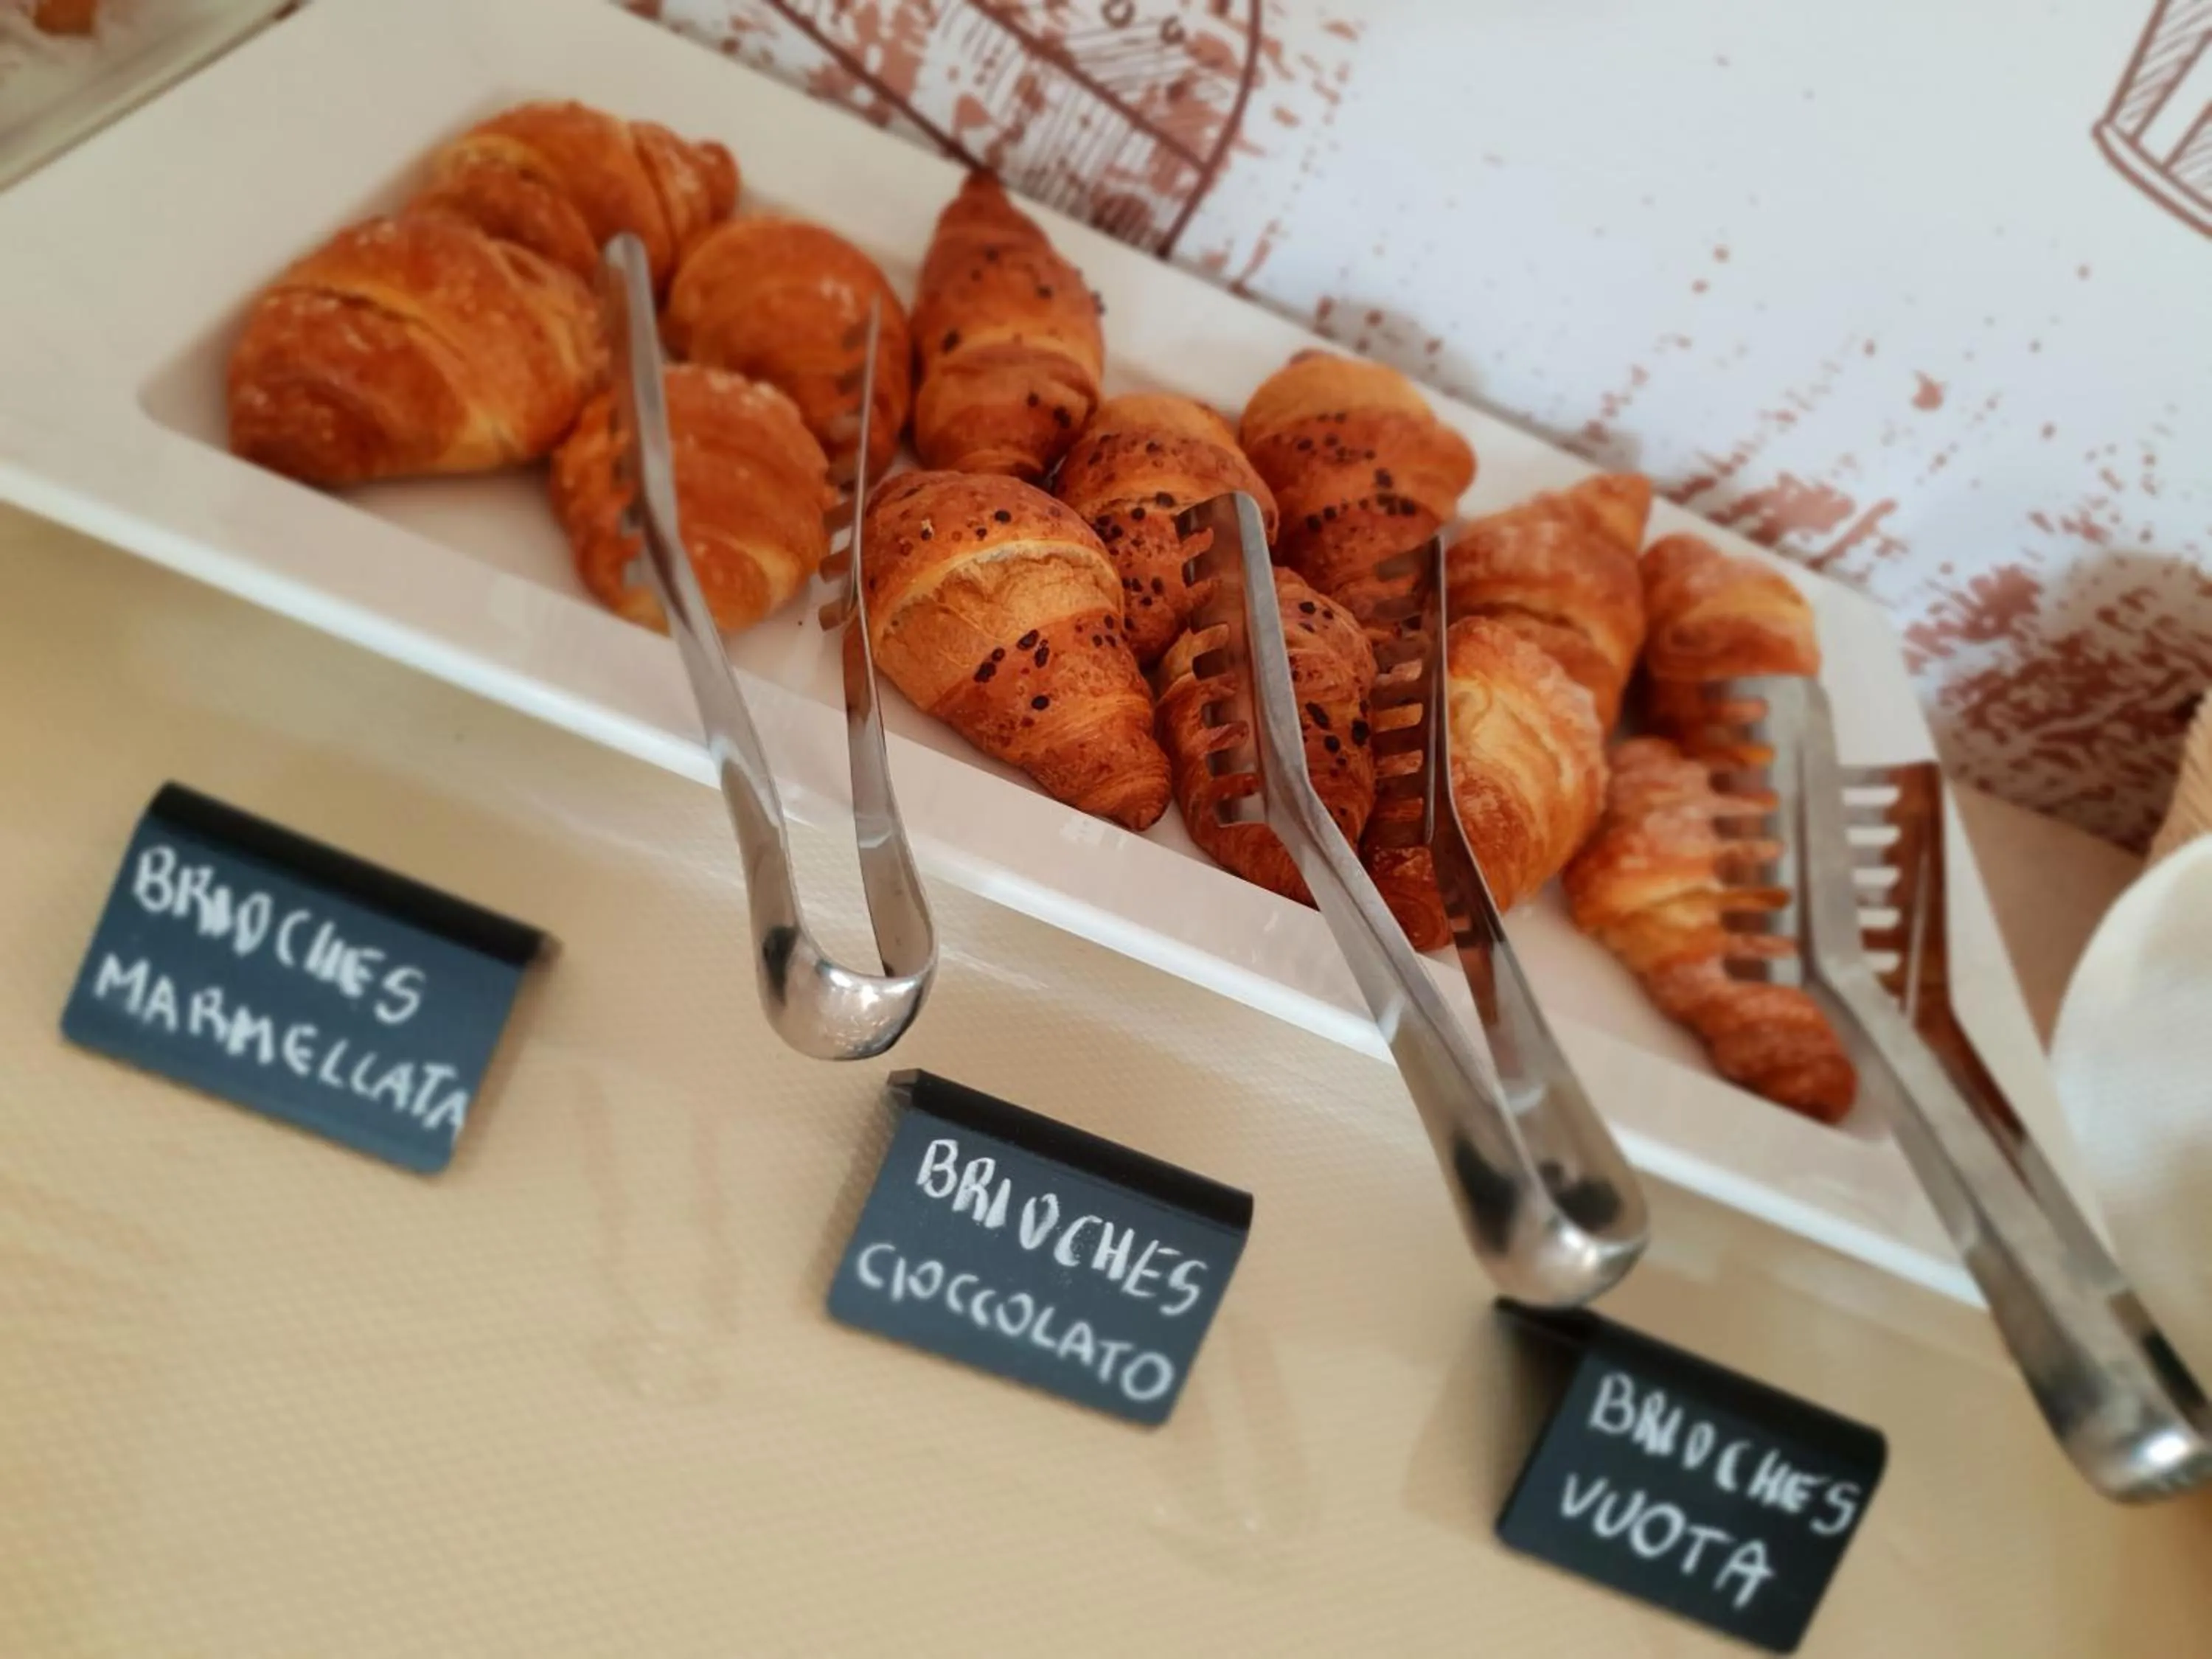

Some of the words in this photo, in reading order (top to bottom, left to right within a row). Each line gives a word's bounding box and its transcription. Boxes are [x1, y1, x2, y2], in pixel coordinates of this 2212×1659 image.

[133, 845, 426, 1024] BRIOCHES
[94, 953, 470, 1130] MARMELLATA
[916, 1138, 1209, 1316] BRIOCHES
[856, 1242, 1175, 1401] CIOCCOLATO
[1588, 1371, 1862, 1537] BRIOCHES
[1560, 1472, 1775, 1610] VUOTA
